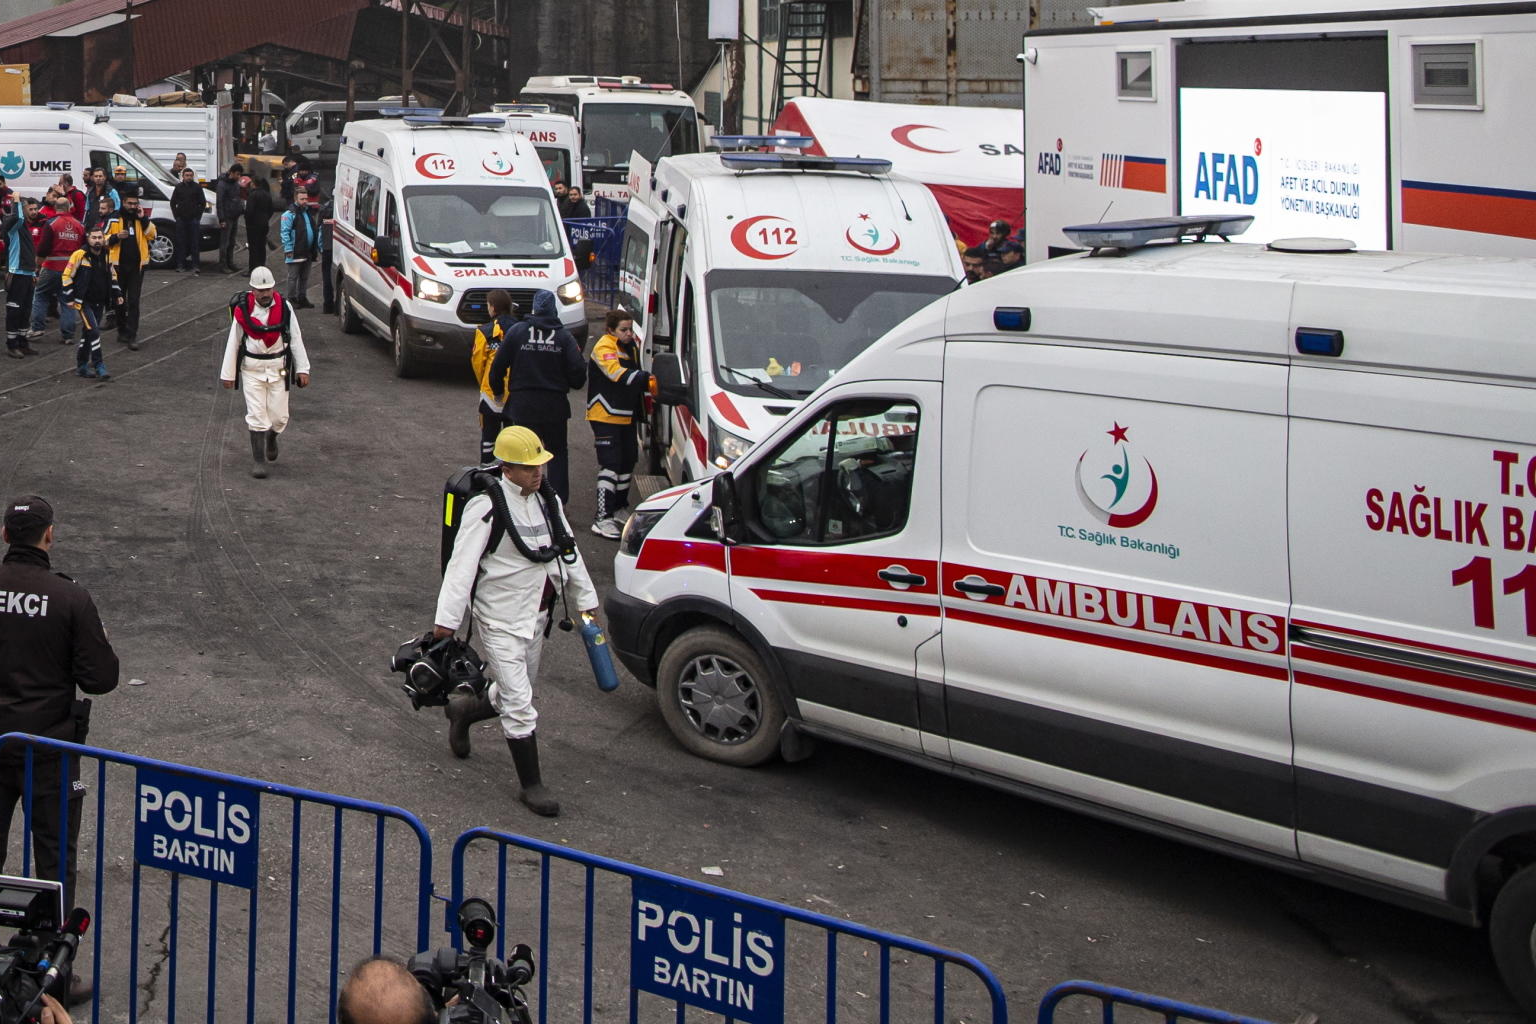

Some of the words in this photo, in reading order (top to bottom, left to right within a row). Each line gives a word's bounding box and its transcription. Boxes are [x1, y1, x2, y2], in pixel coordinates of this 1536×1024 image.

[529, 131, 557, 142] ANS
[29, 160, 72, 172] UMKE
[431, 159, 455, 170] 112
[1038, 152, 1061, 175] AFAD
[1194, 151, 1259, 205] AFAD
[1280, 176, 1298, 190] AFET
[1300, 178, 1309, 191] VE
[1330, 181, 1360, 197] DURUM
[571, 227, 589, 239] POLİS
[758, 227, 798, 245] 112
[527, 326, 556, 345] 112
[1365, 484, 1490, 547] SAĞLIK
[1057, 525, 1076, 539] T.C.
[1078, 528, 1117, 546] Sağlık
[1120, 536, 1180, 559] Bakanlığı
[1004, 574, 1280, 653] AMBULANS
[140, 784, 251, 844] POLİS
[153, 834, 234, 874] BARTIN
[638, 899, 774, 977] POLİS
[654, 956, 754, 1012] BARTIN
